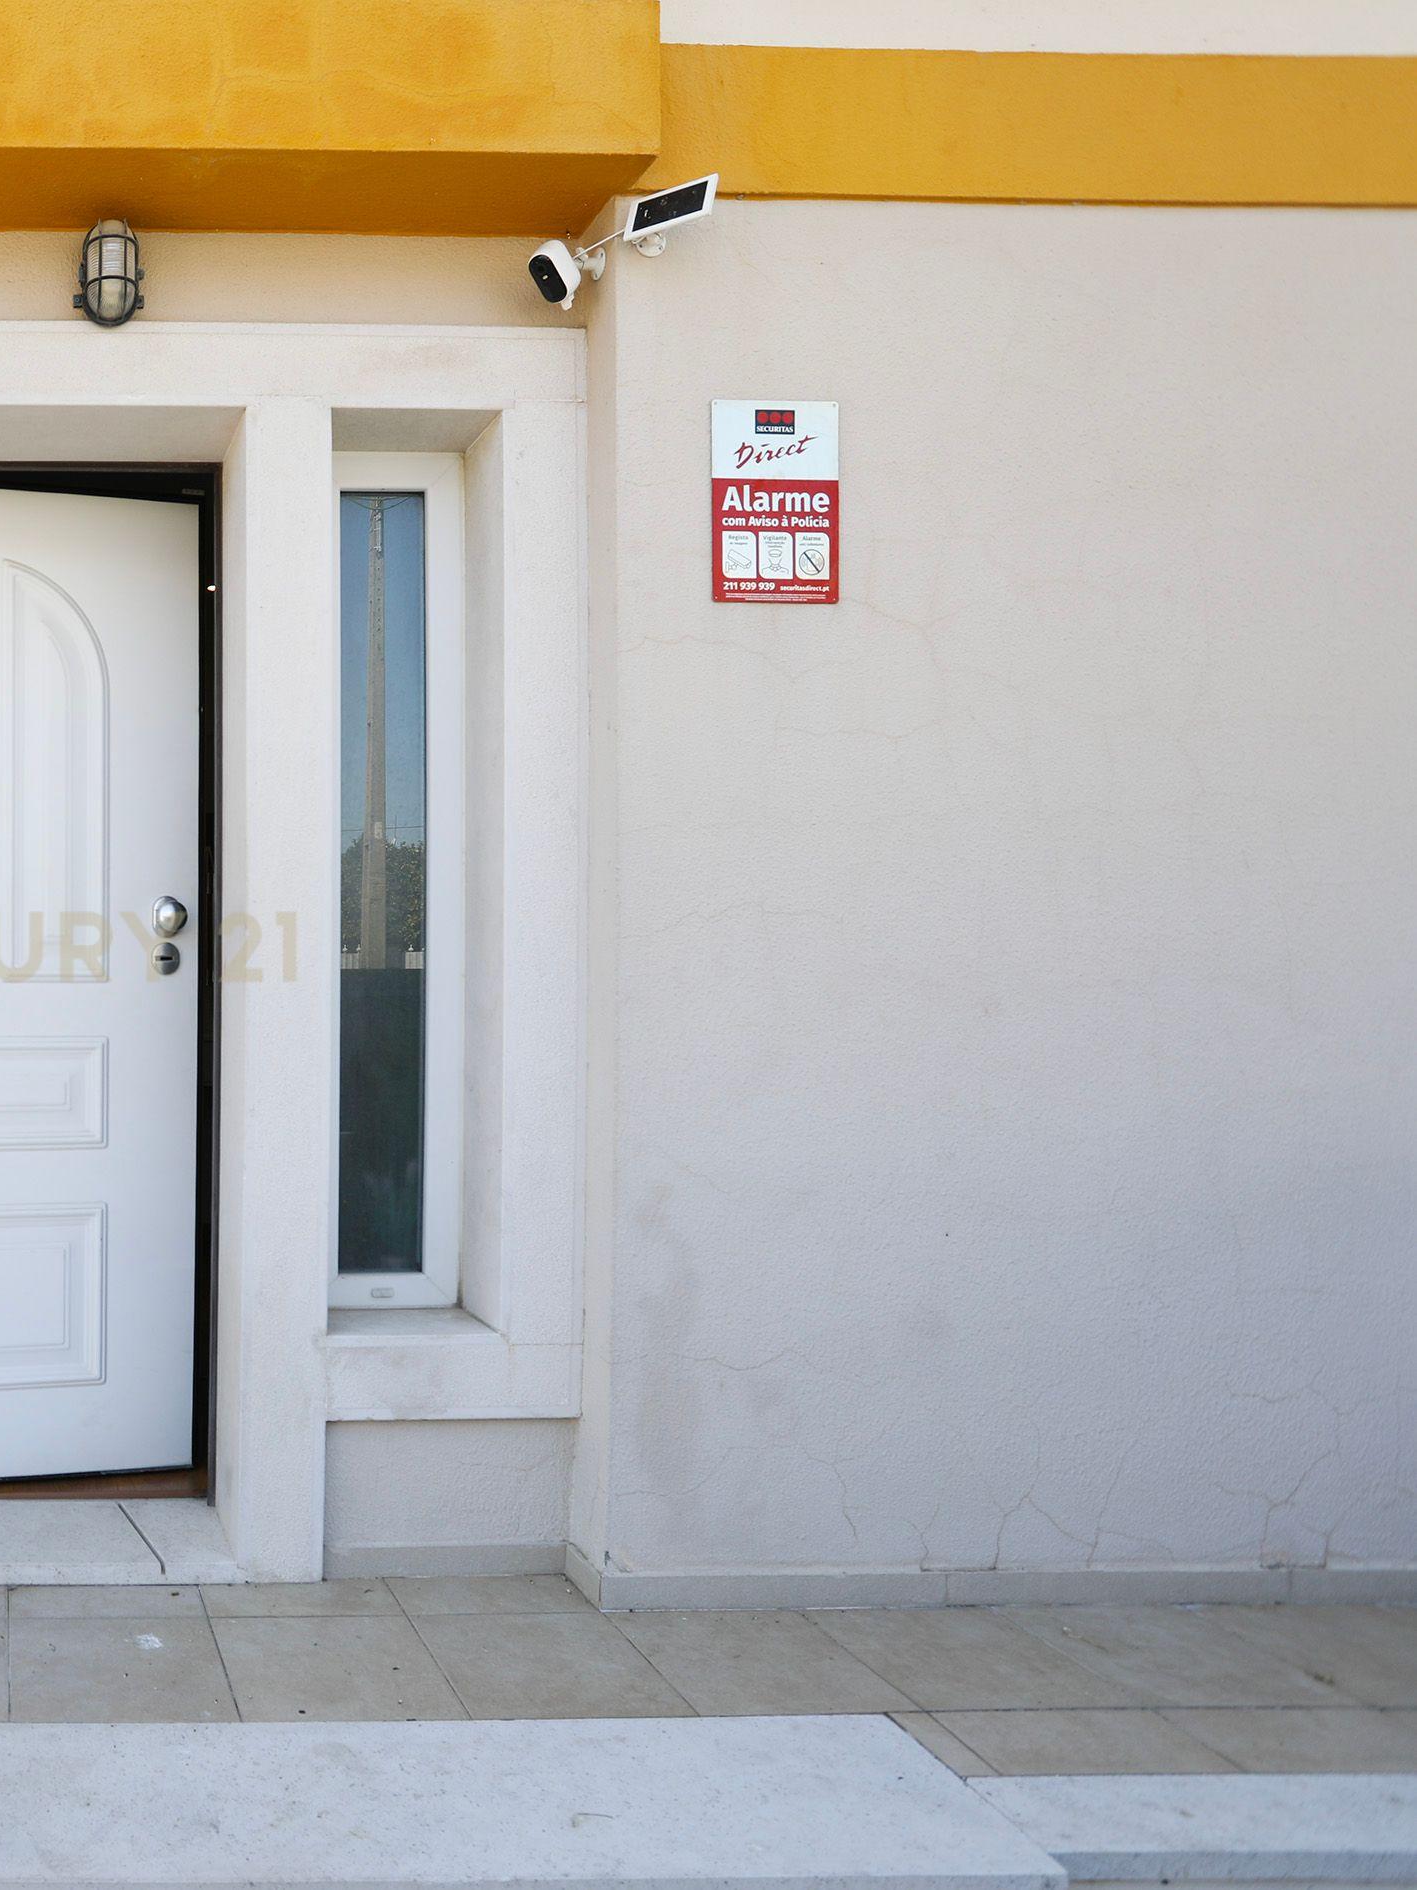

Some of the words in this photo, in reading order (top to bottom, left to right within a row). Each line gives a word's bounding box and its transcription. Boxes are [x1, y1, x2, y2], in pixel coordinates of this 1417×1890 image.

[756, 425, 794, 433] SECURITAS
[734, 435, 818, 469] Direct
[722, 484, 830, 513] Alarme
[722, 517, 746, 527] com
[748, 515, 779, 527] Aviso
[781, 515, 788, 527] à
[791, 515, 830, 528] Polícia
[723, 582, 738, 591] 211
[739, 582, 757, 591] 939
[758, 582, 776, 591] 939
